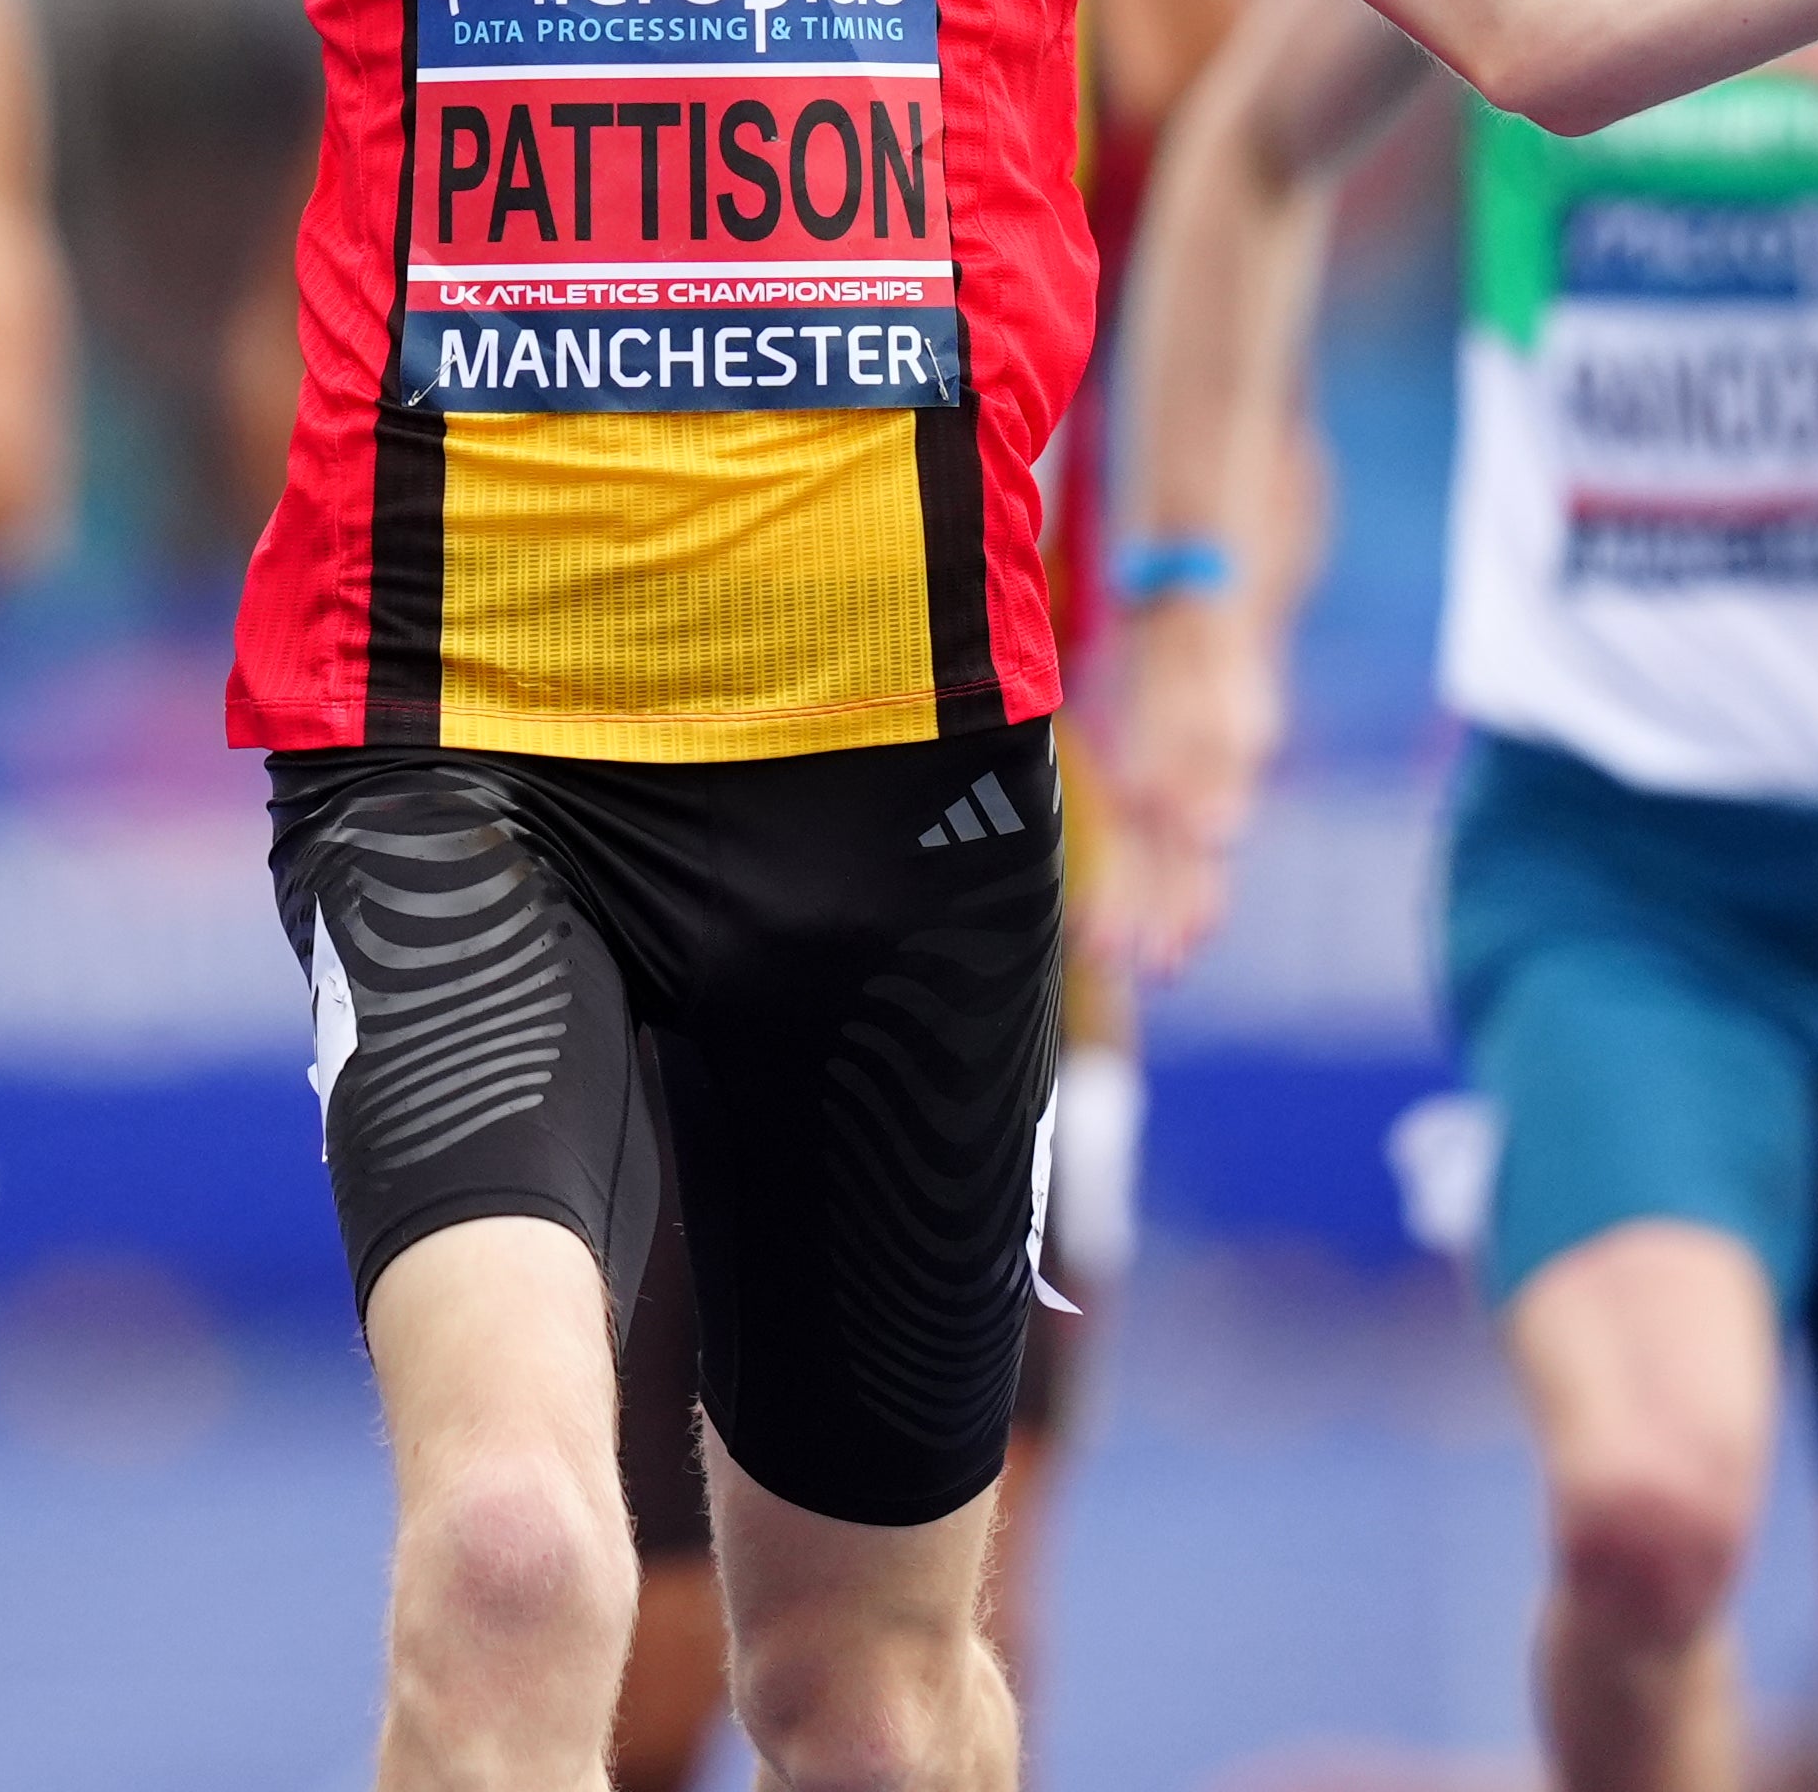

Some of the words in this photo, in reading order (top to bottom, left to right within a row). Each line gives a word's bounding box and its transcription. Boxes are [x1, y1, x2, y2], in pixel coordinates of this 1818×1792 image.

[453, 19, 525, 45] DATA
[537, 17, 748, 42] PROCESSING
[770, 16, 791, 40] &
[801, 16, 905, 41] TIMING
[437, 100, 928, 245] PATTISON
[439, 284, 481, 306] UK
[485, 283, 659, 306] ATHLETICS
[667, 280, 924, 303] CHAMPIONSHIPS
[438, 325, 928, 389] MANCHESTER
